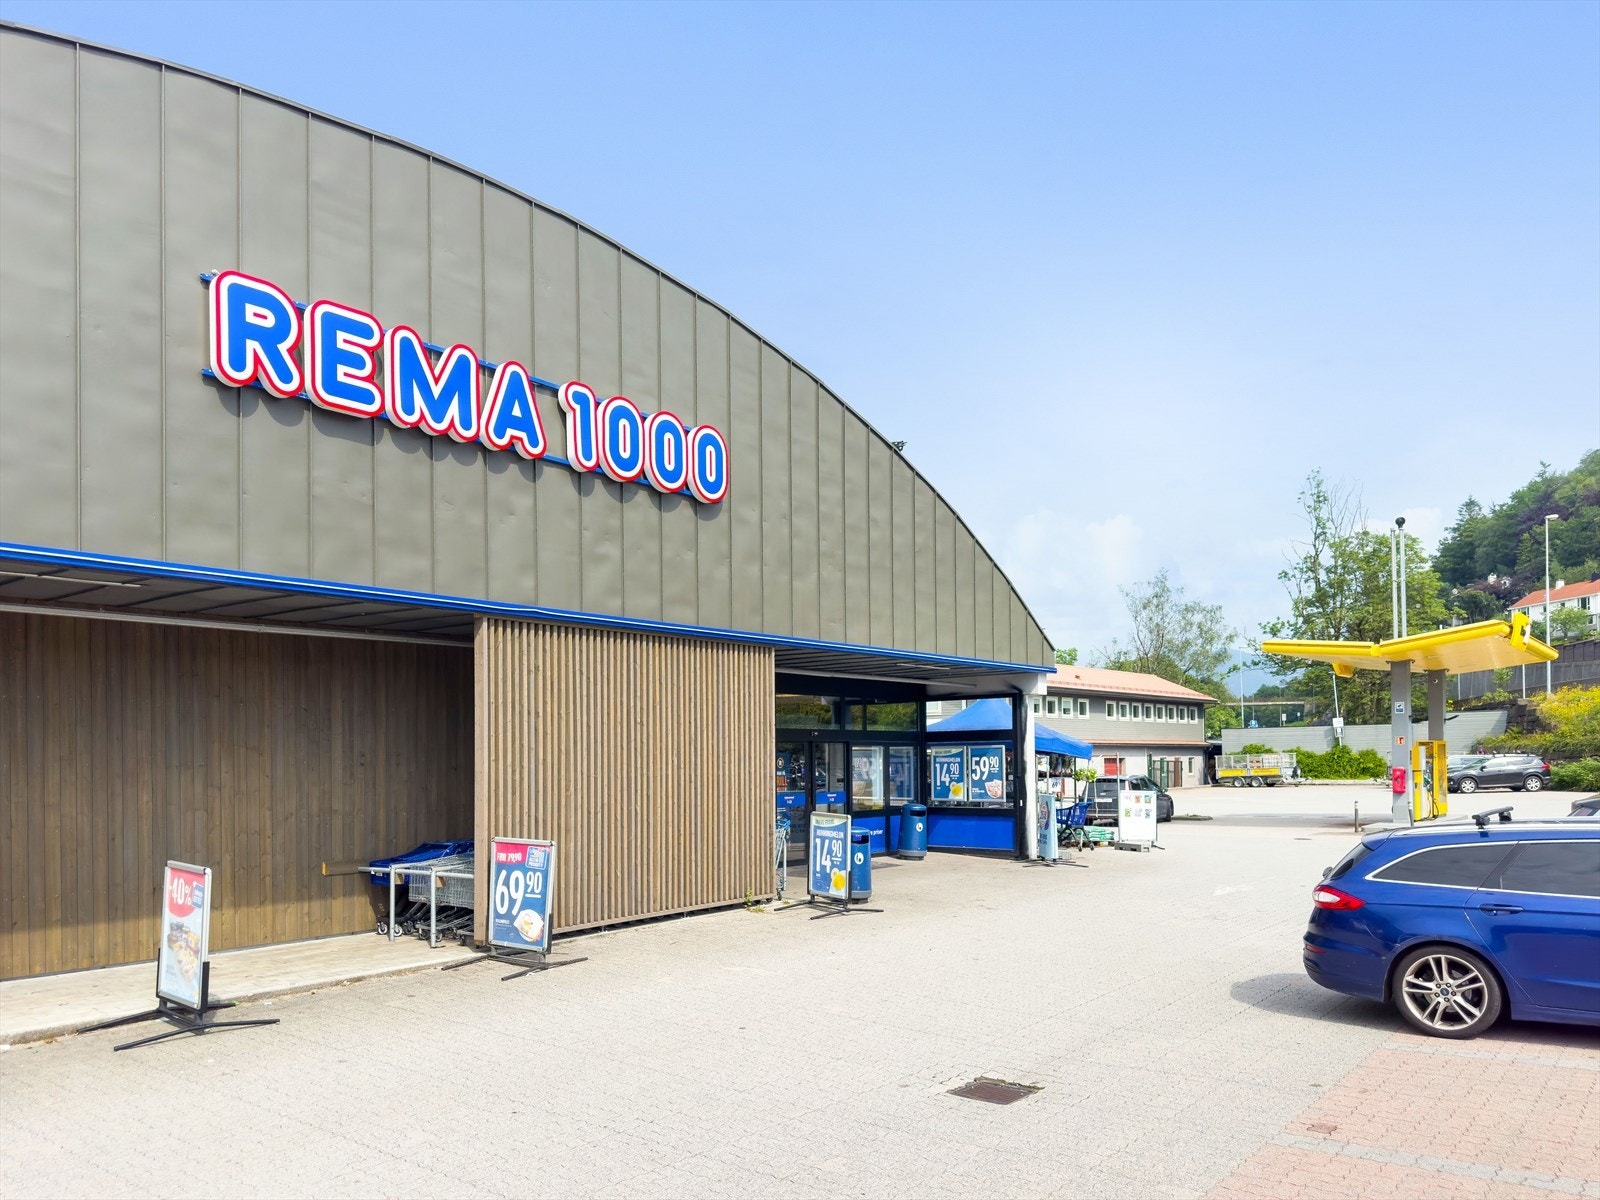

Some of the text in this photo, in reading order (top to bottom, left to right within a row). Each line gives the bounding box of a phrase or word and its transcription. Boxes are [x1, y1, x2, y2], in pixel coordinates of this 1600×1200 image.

[209, 270, 728, 503] REMA 1000
[935, 763, 960, 787] 14 90
[971, 756, 999, 781] 59 90
[815, 838, 843, 874] 14 90
[495, 869, 543, 916] 69 90
